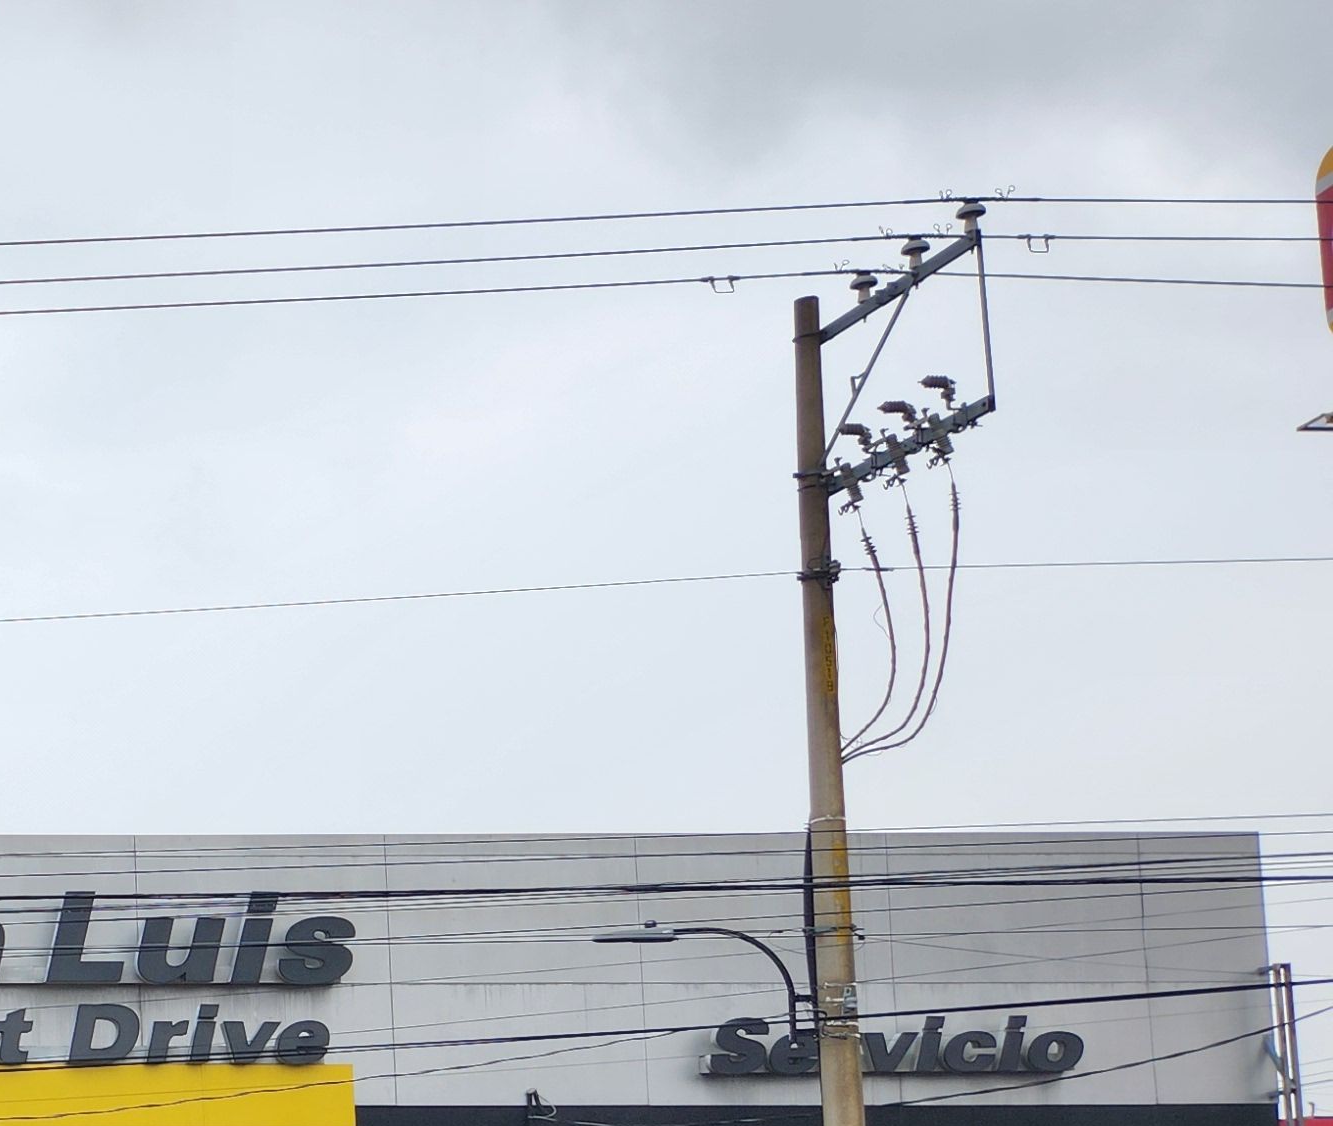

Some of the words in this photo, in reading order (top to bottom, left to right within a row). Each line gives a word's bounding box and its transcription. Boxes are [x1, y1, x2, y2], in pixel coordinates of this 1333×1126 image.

[44, 891, 356, 985] Luis
[68, 1003, 331, 1065] Drive
[709, 1015, 1085, 1073] Sevicio
